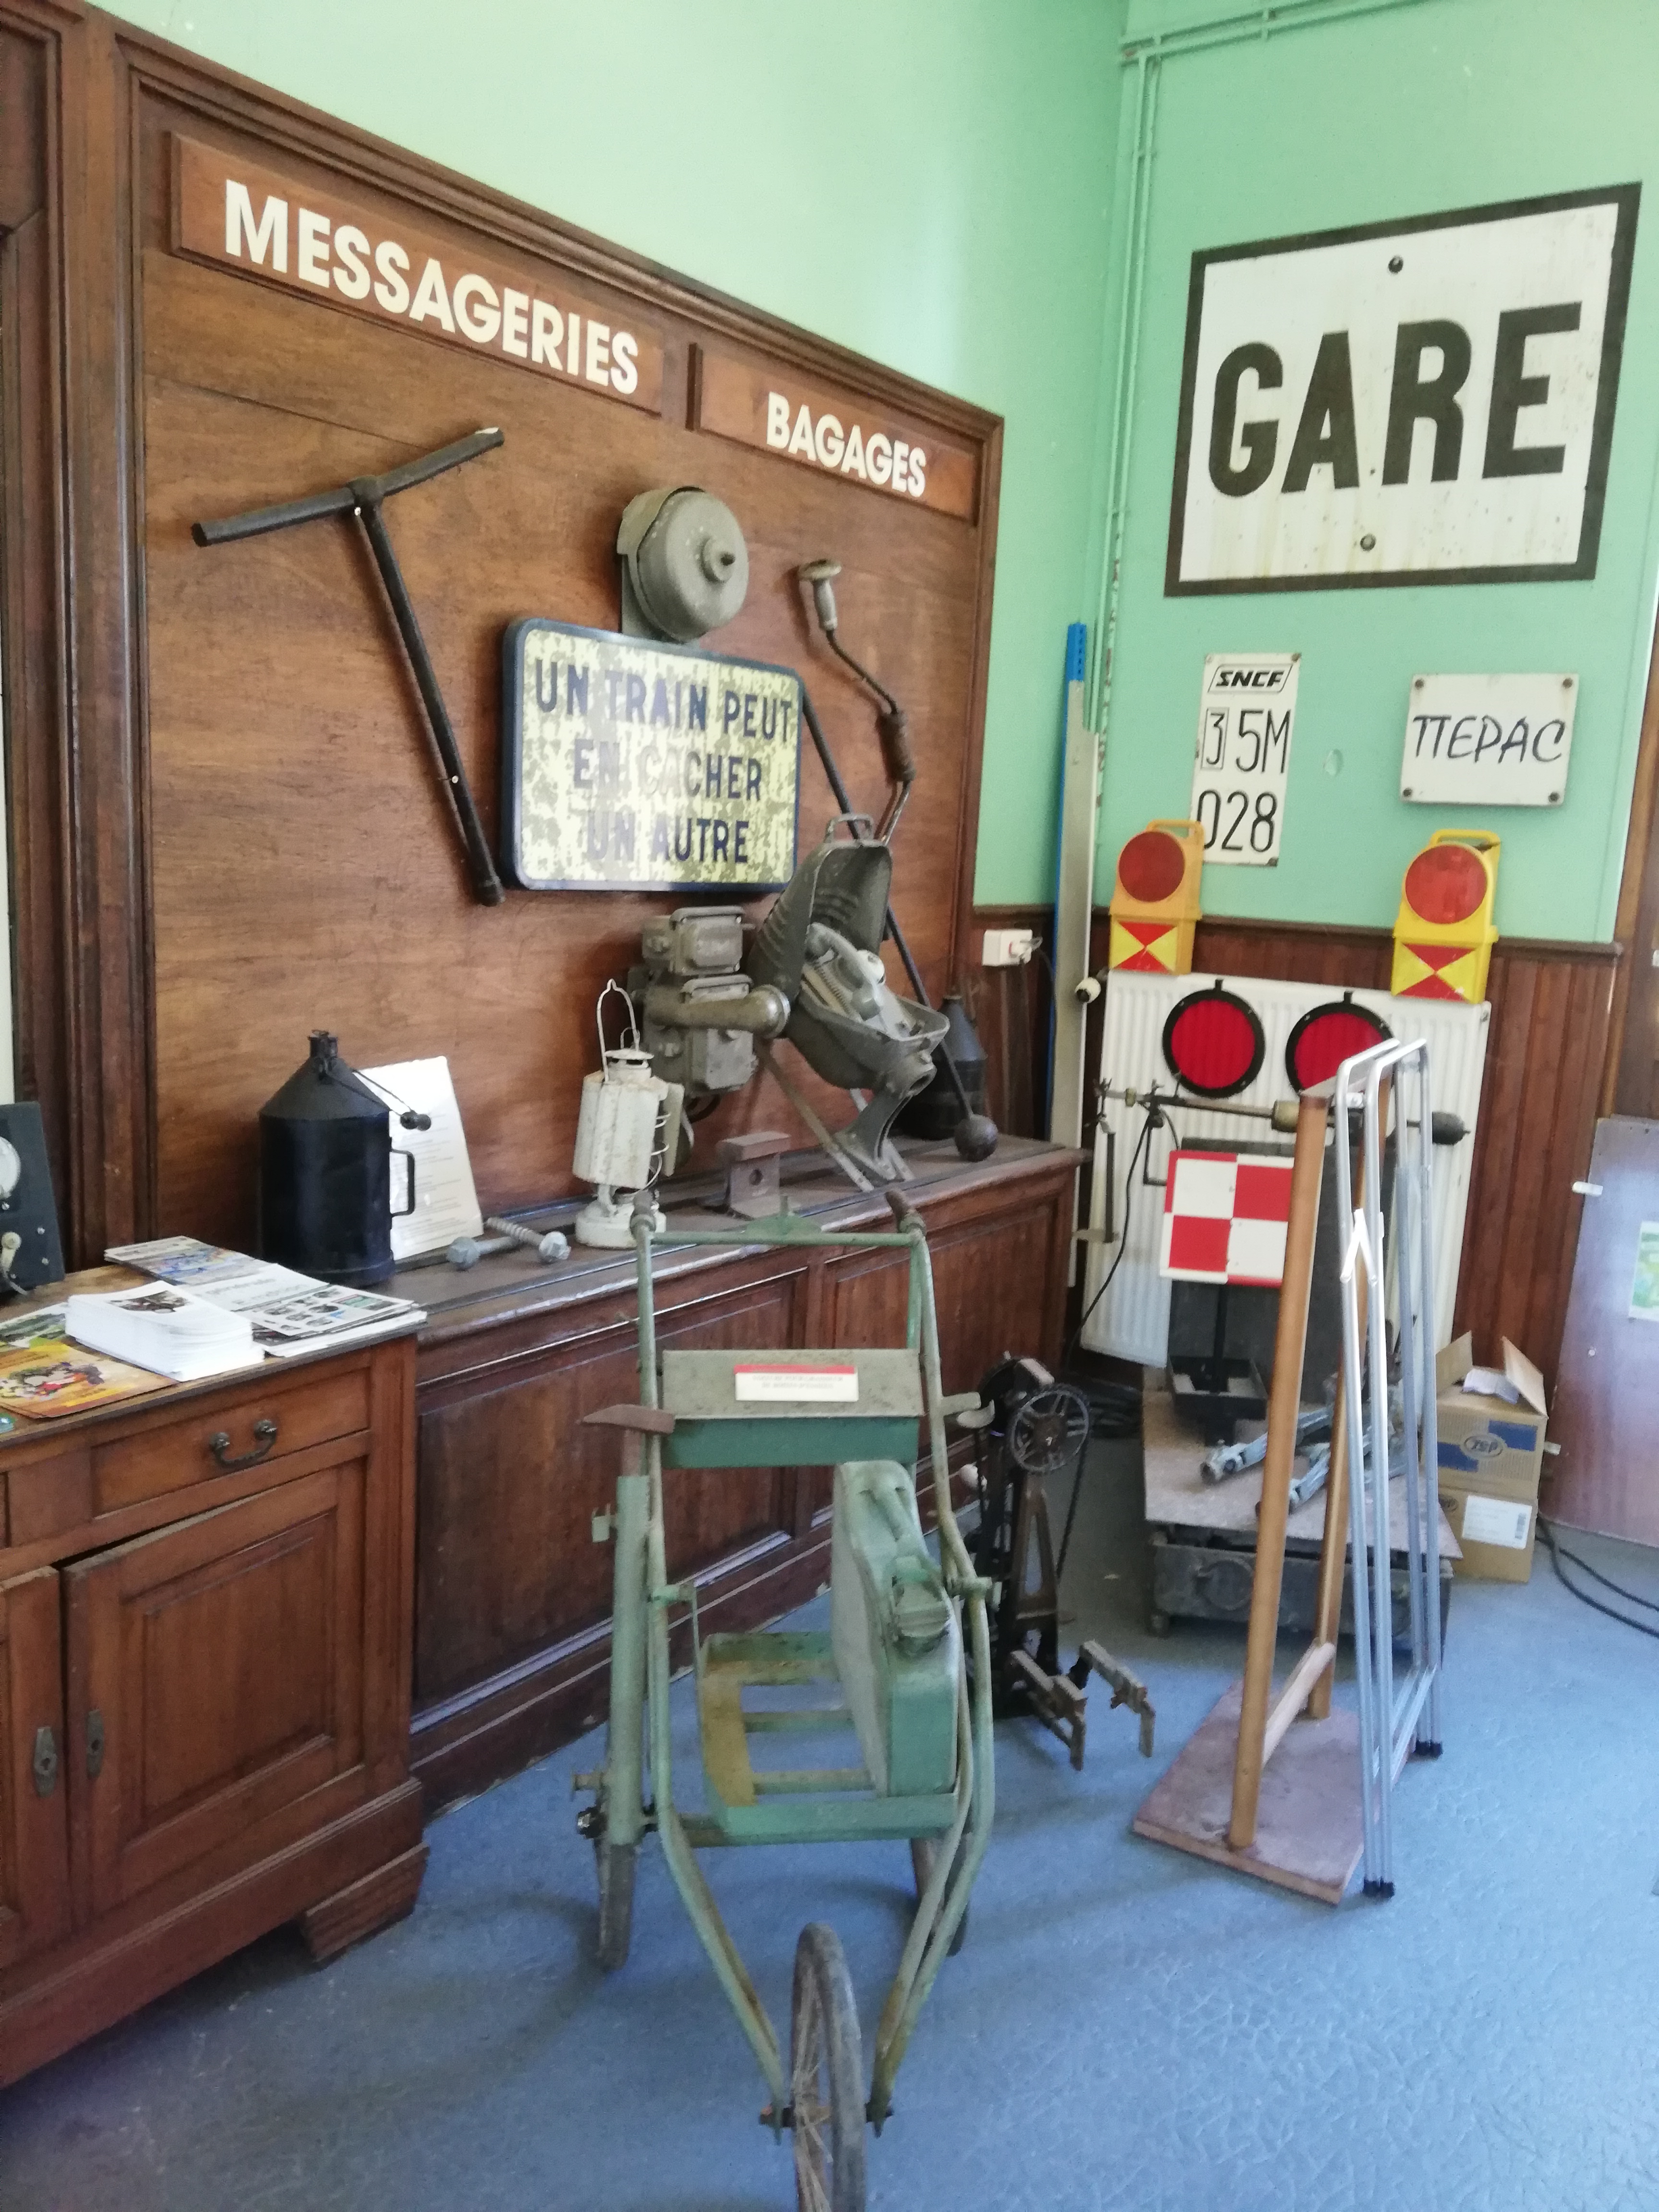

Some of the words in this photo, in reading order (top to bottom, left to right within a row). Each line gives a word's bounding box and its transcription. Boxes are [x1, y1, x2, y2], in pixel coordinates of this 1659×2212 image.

[225, 180, 638, 394] MESSAGERIES
[1208, 301, 1582, 497] GARE
[767, 391, 926, 497] BAGAGES
[535, 658, 588, 715] UN
[605, 669, 707, 732] TRAIN
[724, 690, 792, 743] PEUT
[1216, 670, 1284, 687] SNCF
[573, 739, 619, 793] EN
[638, 744, 762, 801] CACHER
[588, 811, 635, 862] UN
[651, 816, 749, 864] AUTRE
[1197, 789, 1278, 853] 028
